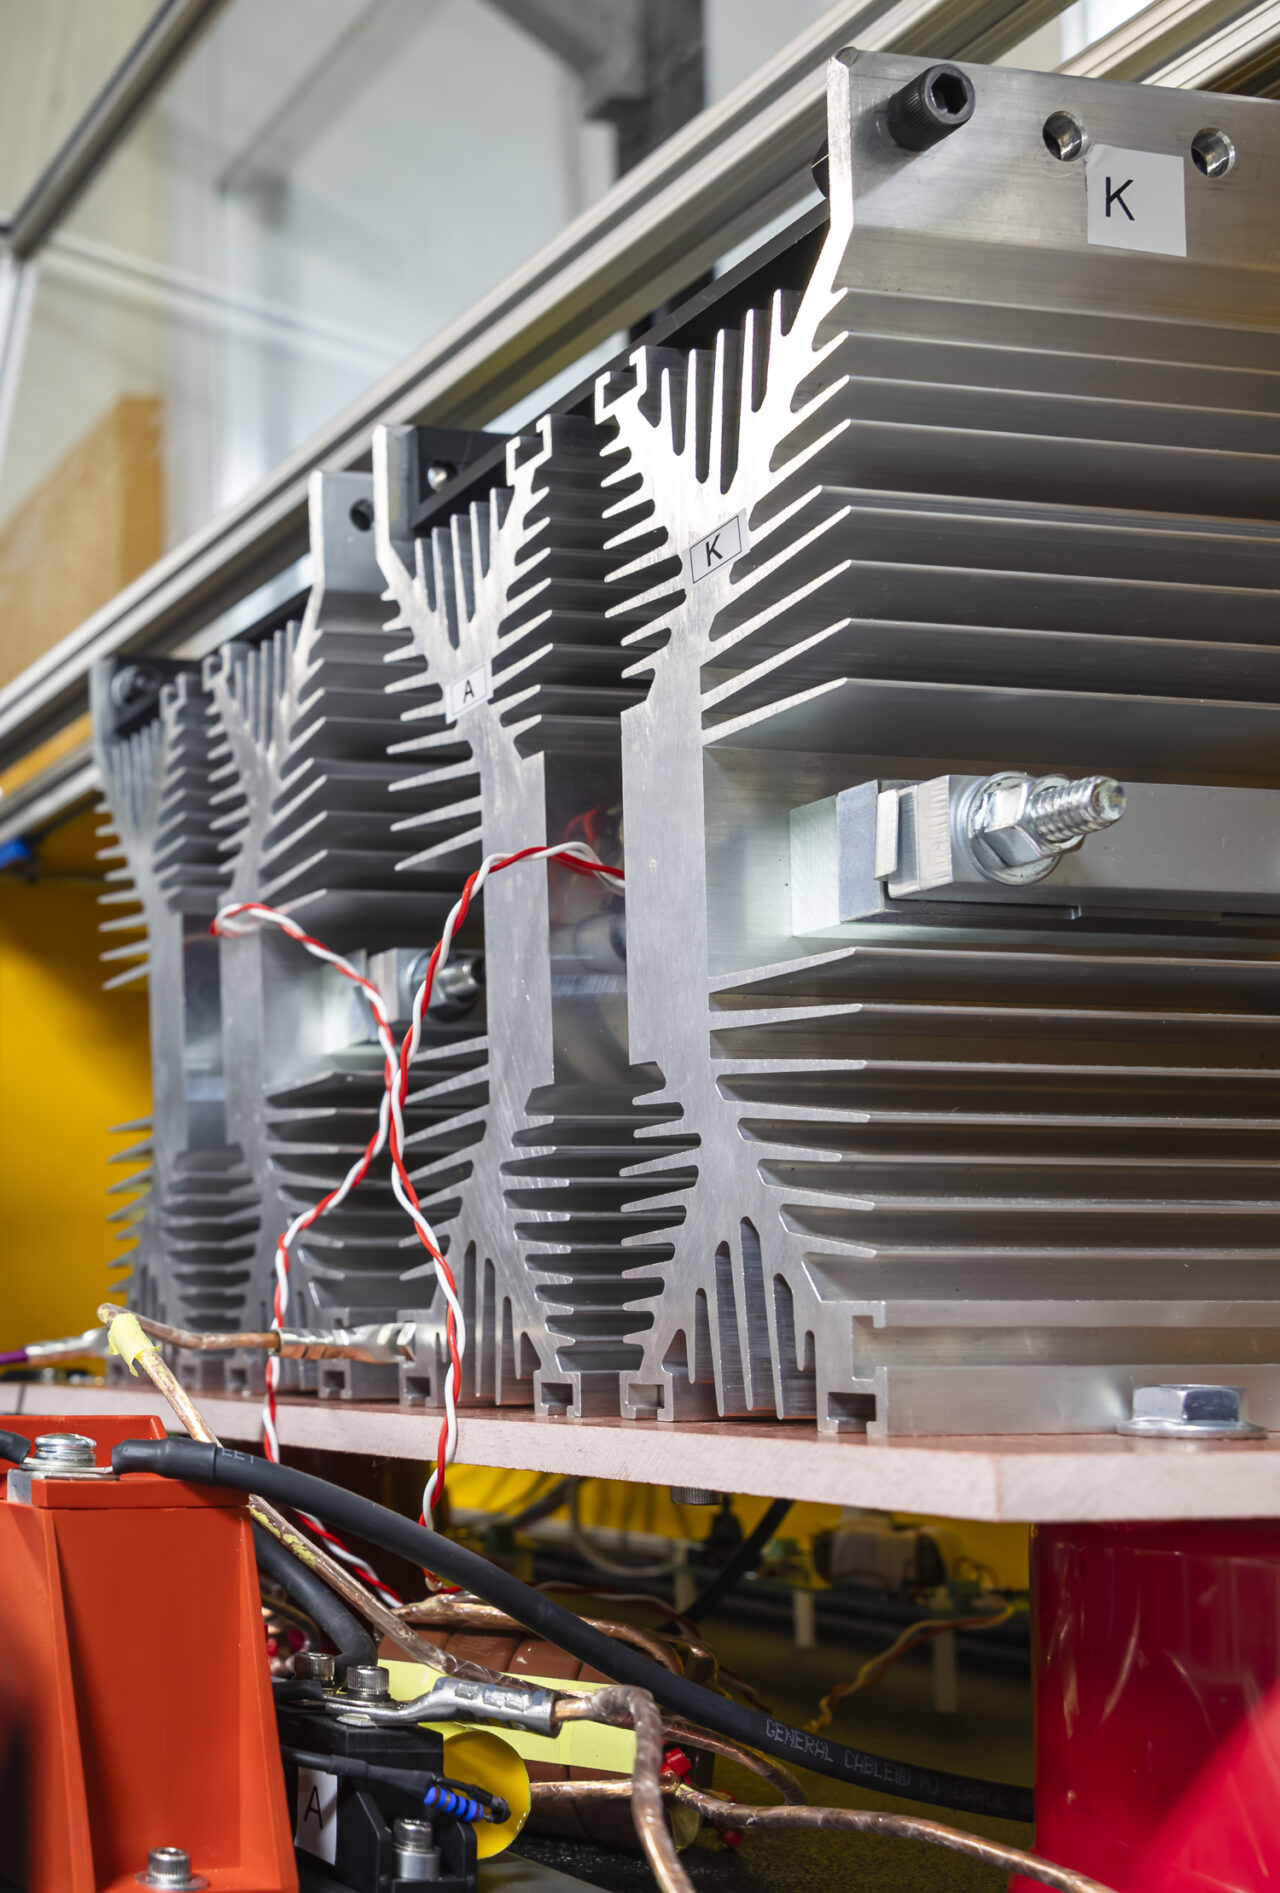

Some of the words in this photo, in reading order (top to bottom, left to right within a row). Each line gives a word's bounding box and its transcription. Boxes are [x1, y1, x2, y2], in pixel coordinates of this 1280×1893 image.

[1105, 176, 1135, 221] K
[705, 533, 723, 567] K
[463, 679, 475, 704] A
[766, 1718, 834, 1763] GENERAL
[303, 1785, 323, 1830] A
